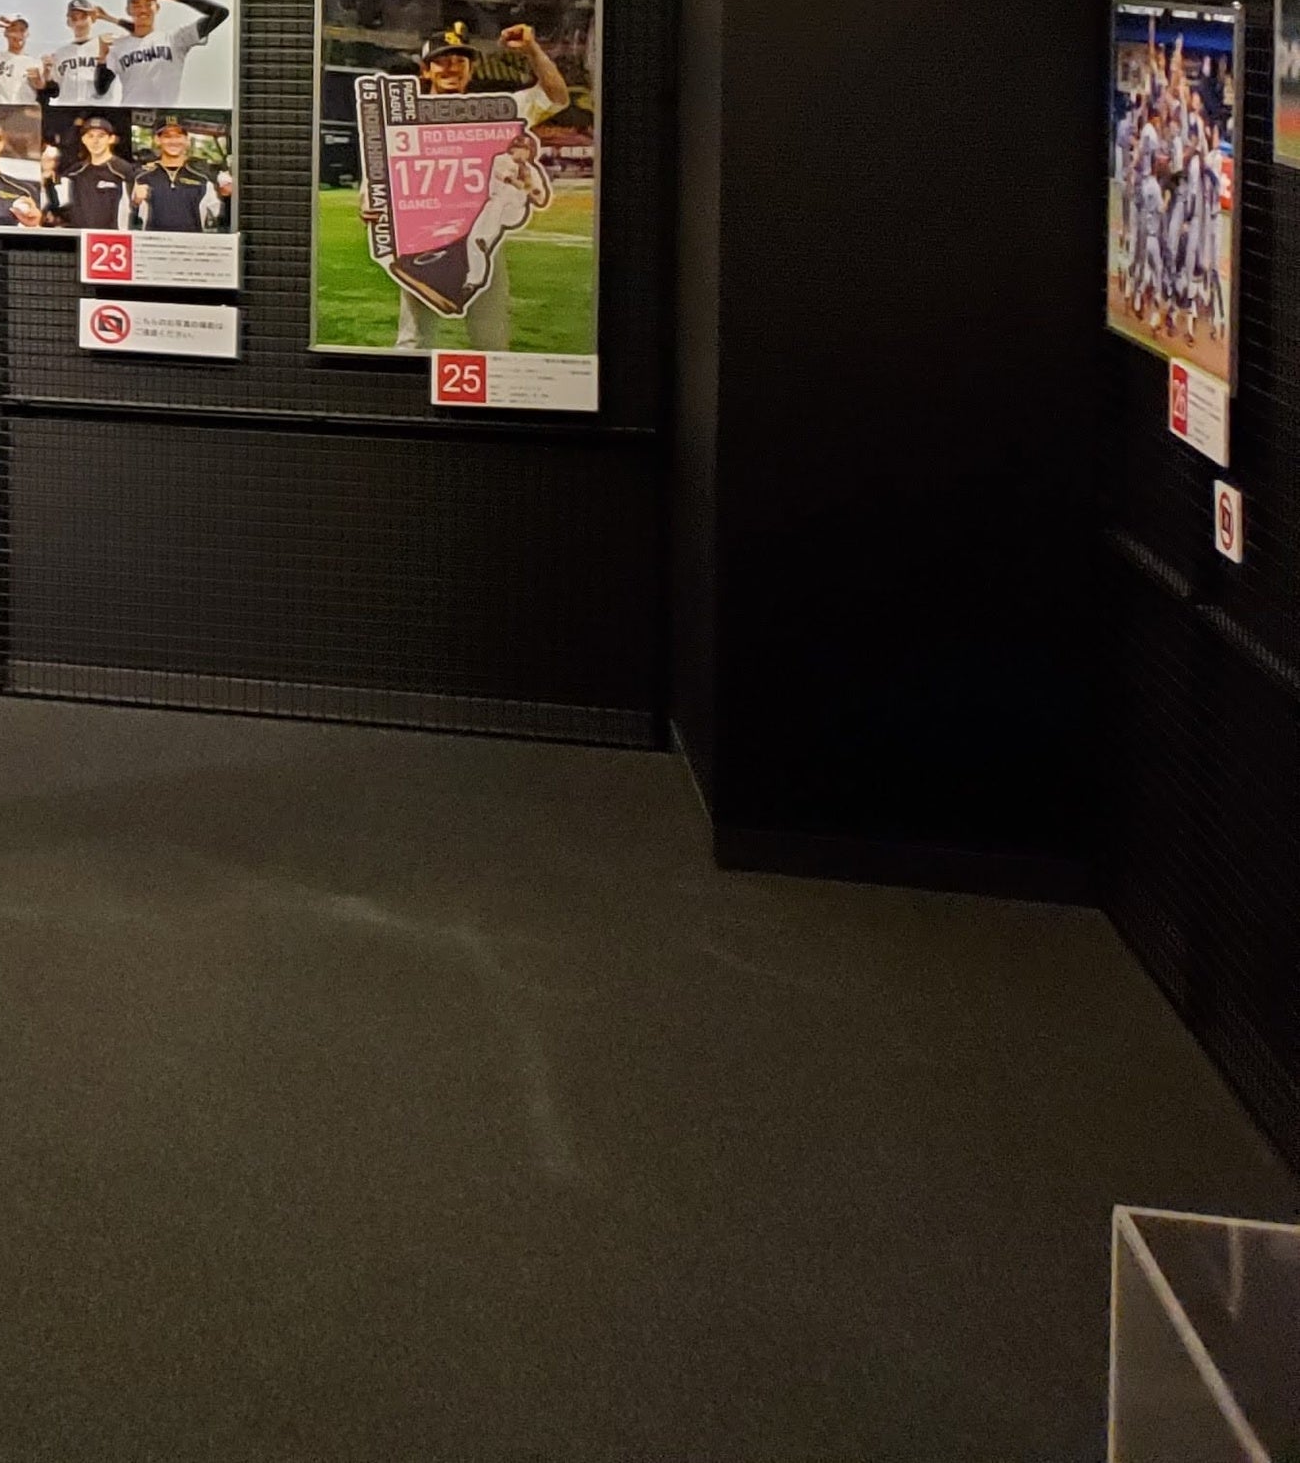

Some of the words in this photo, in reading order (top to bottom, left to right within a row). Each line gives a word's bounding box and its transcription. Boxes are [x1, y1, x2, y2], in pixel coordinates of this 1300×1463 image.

[118, 45, 173, 72] YOKOHAMA
[389, 81, 402, 123] LEAGUE
[420, 97, 513, 122] RECORD
[395, 131, 411, 152] 3
[422, 130, 442, 143] RD
[446, 127, 516, 142] BASEMAN
[395, 157, 485, 197] 1775
[399, 198, 441, 211] GAMES
[90, 242, 128, 272] 23
[442, 363, 482, 394] 25
